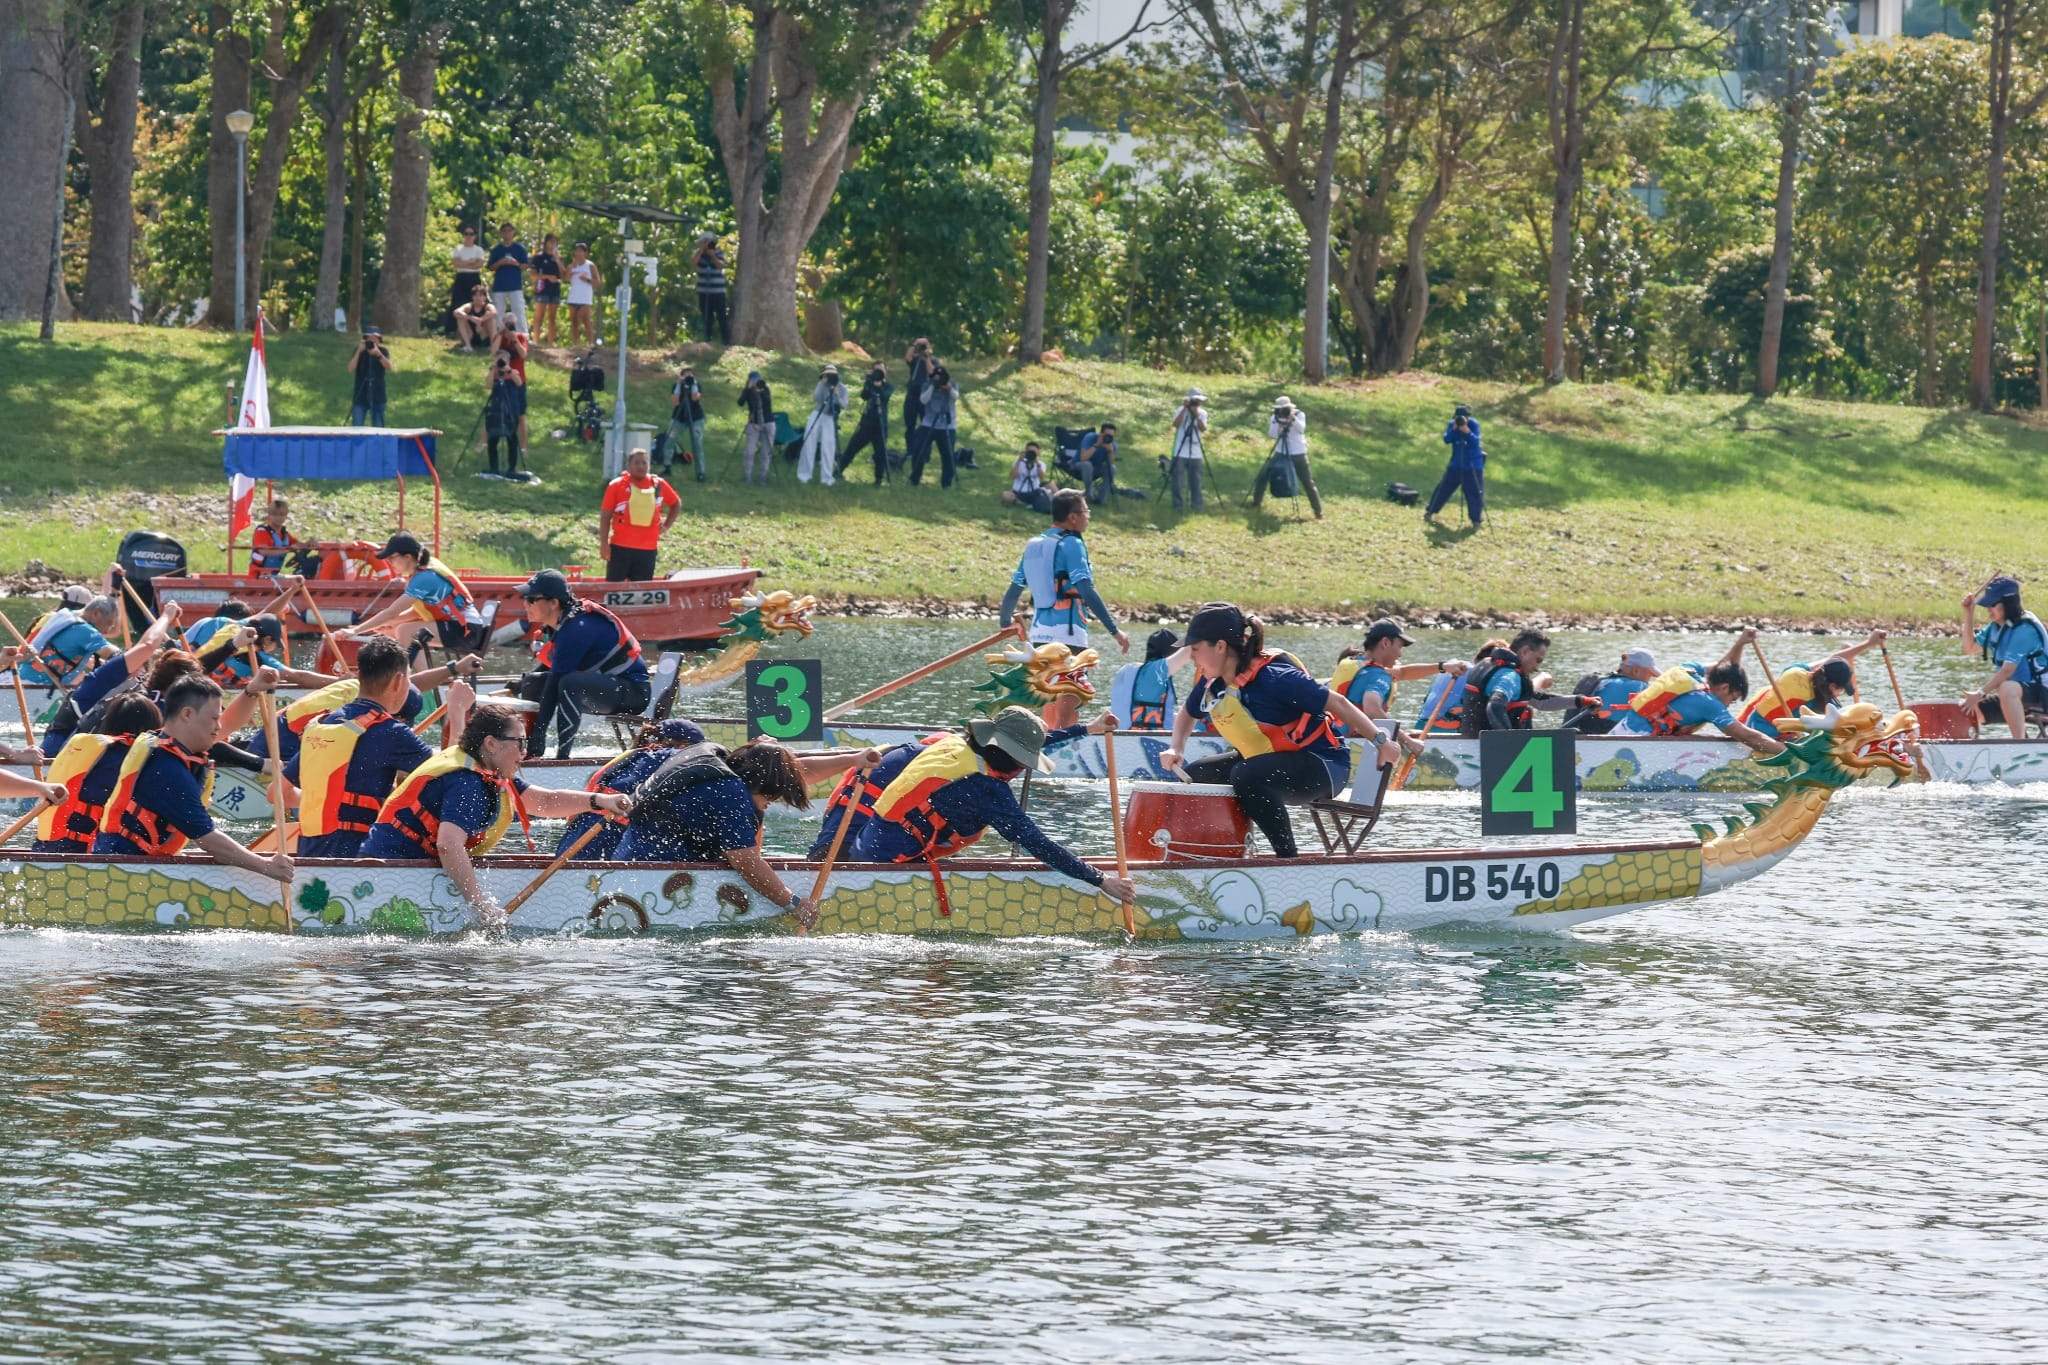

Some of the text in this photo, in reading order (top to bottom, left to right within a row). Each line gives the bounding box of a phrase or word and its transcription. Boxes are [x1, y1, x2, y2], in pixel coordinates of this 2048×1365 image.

[131, 550, 182, 562] MERCURY
[607, 593, 634, 606] RZ
[642, 591, 666, 605] 29
[756, 665, 811, 738] 3
[1491, 736, 1564, 828] 4
[1425, 862, 1560, 902] DB 540
